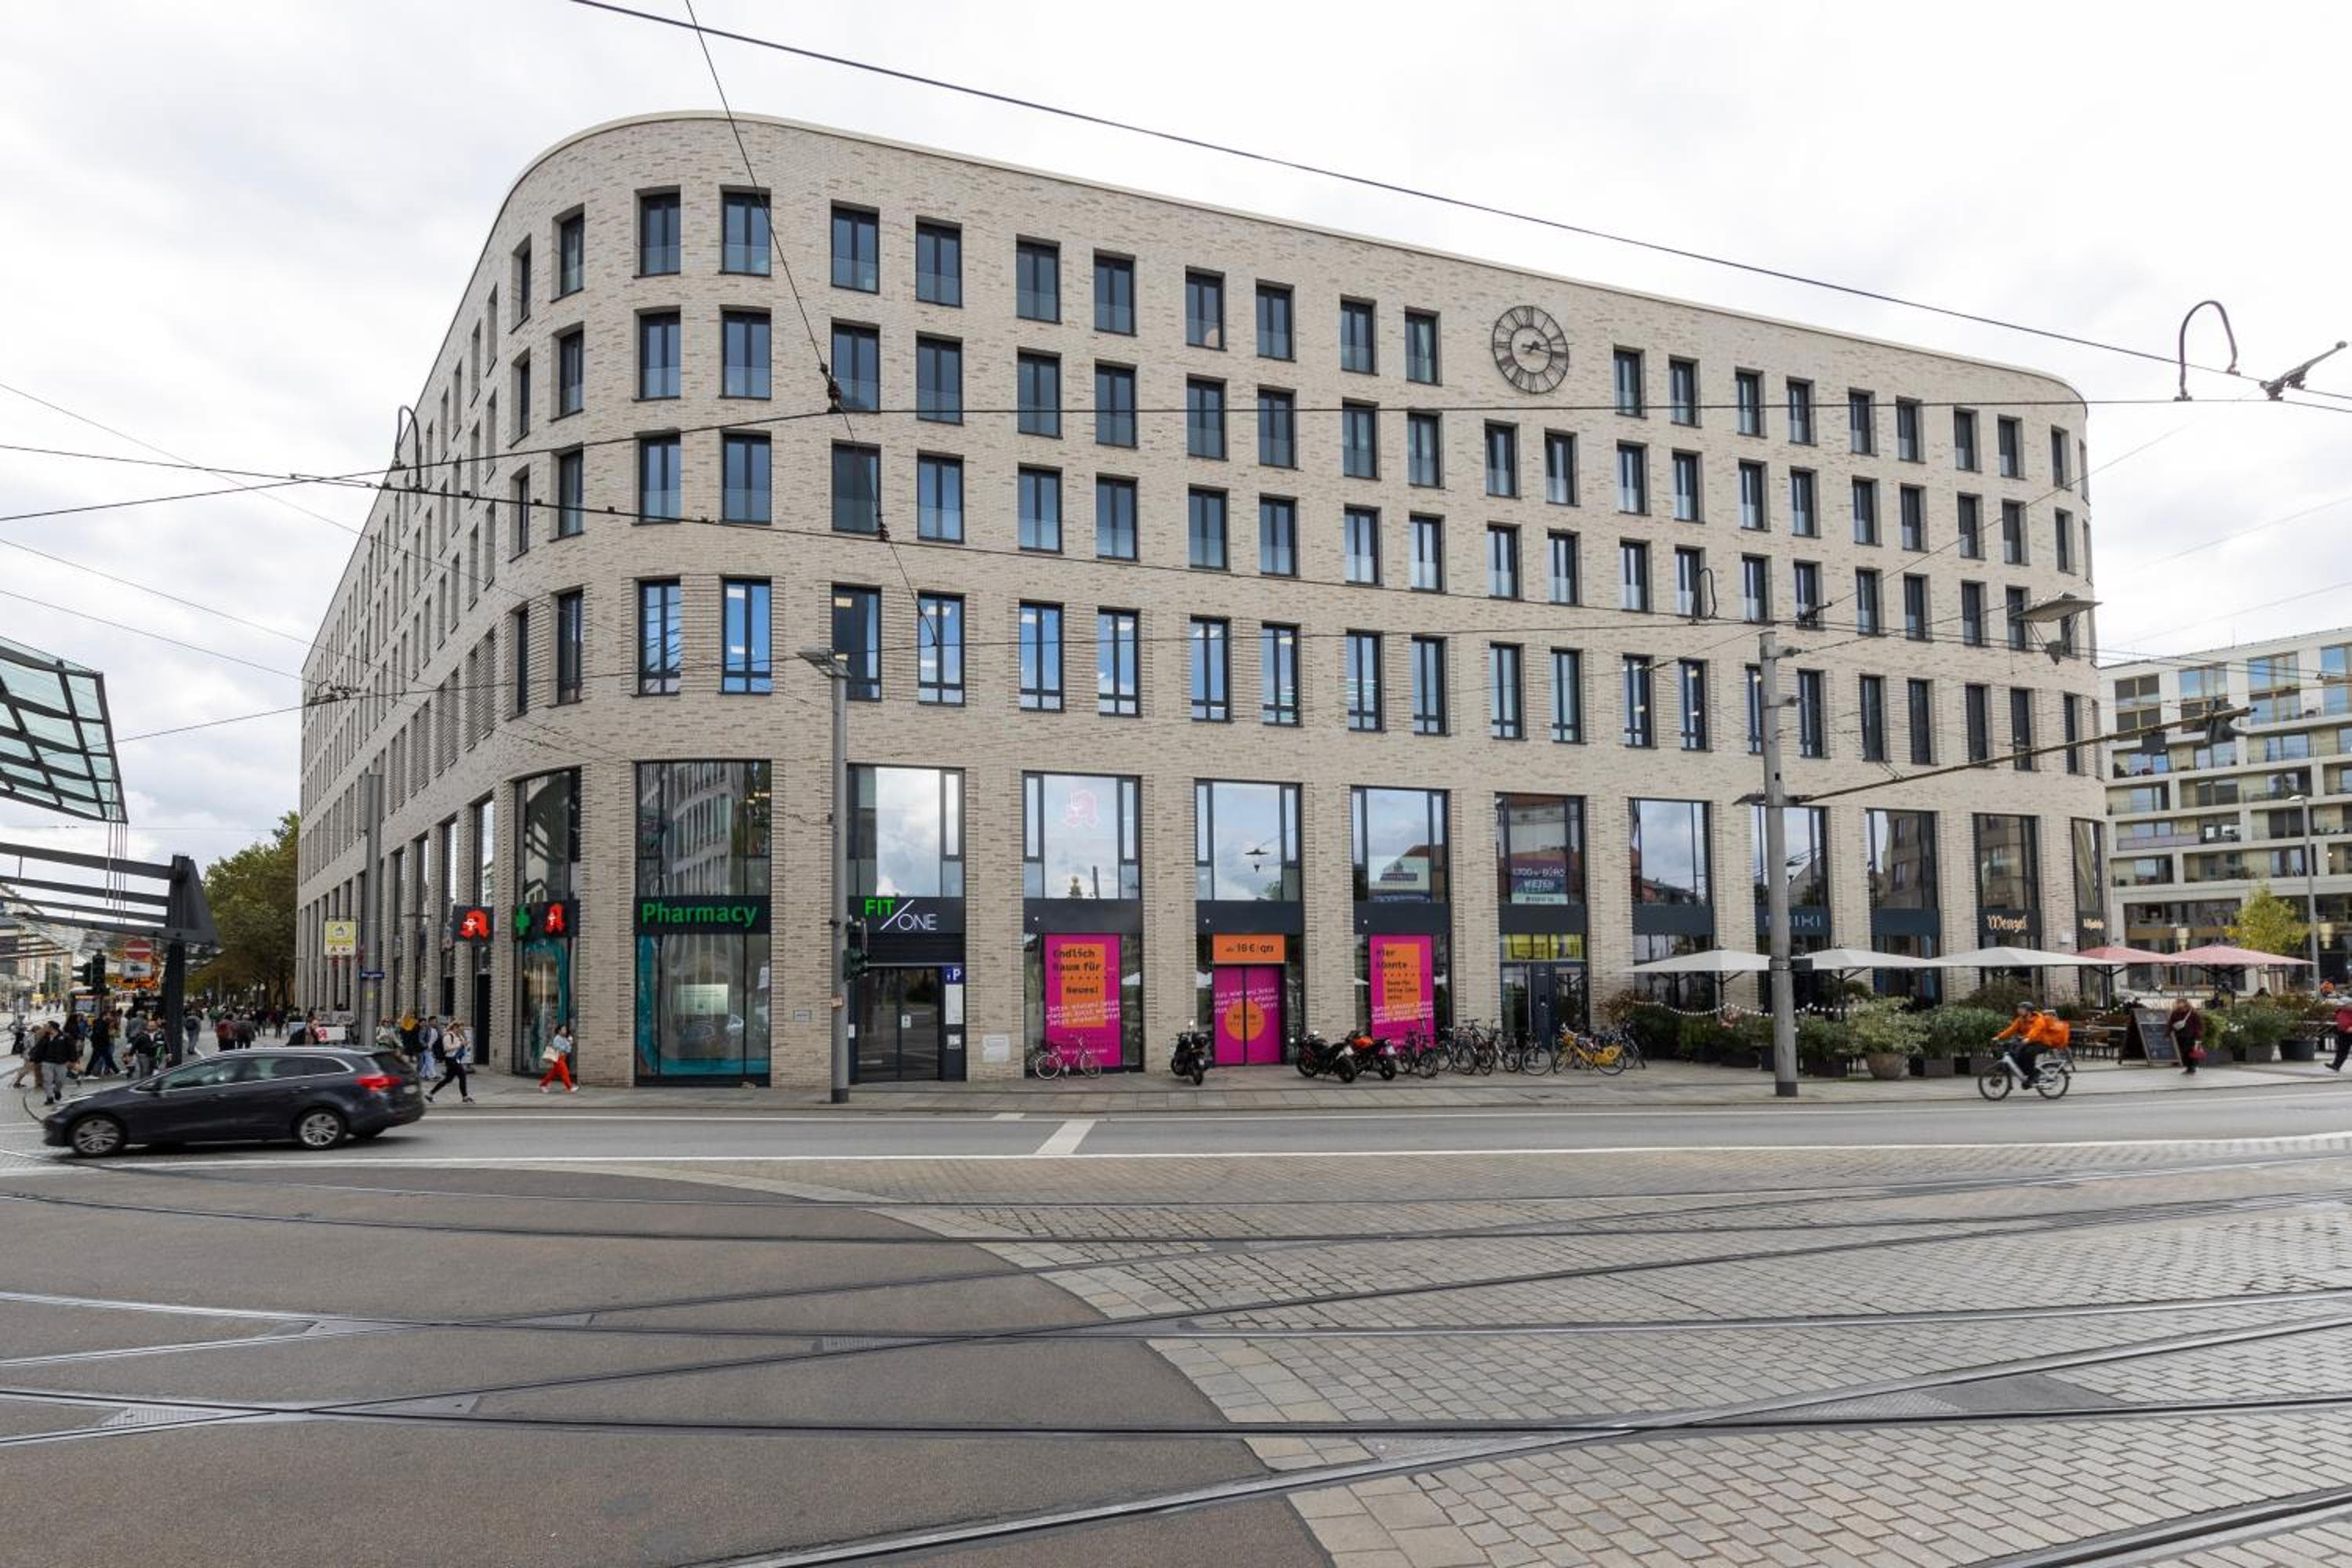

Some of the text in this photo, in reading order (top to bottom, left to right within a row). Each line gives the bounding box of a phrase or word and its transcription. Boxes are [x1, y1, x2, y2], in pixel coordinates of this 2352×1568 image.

[642, 902, 757, 927] Pharmacy
[865, 899, 937, 931] FIT ONE
[953, 968, 961, 980] P
[1083, 961, 1101, 971] für
